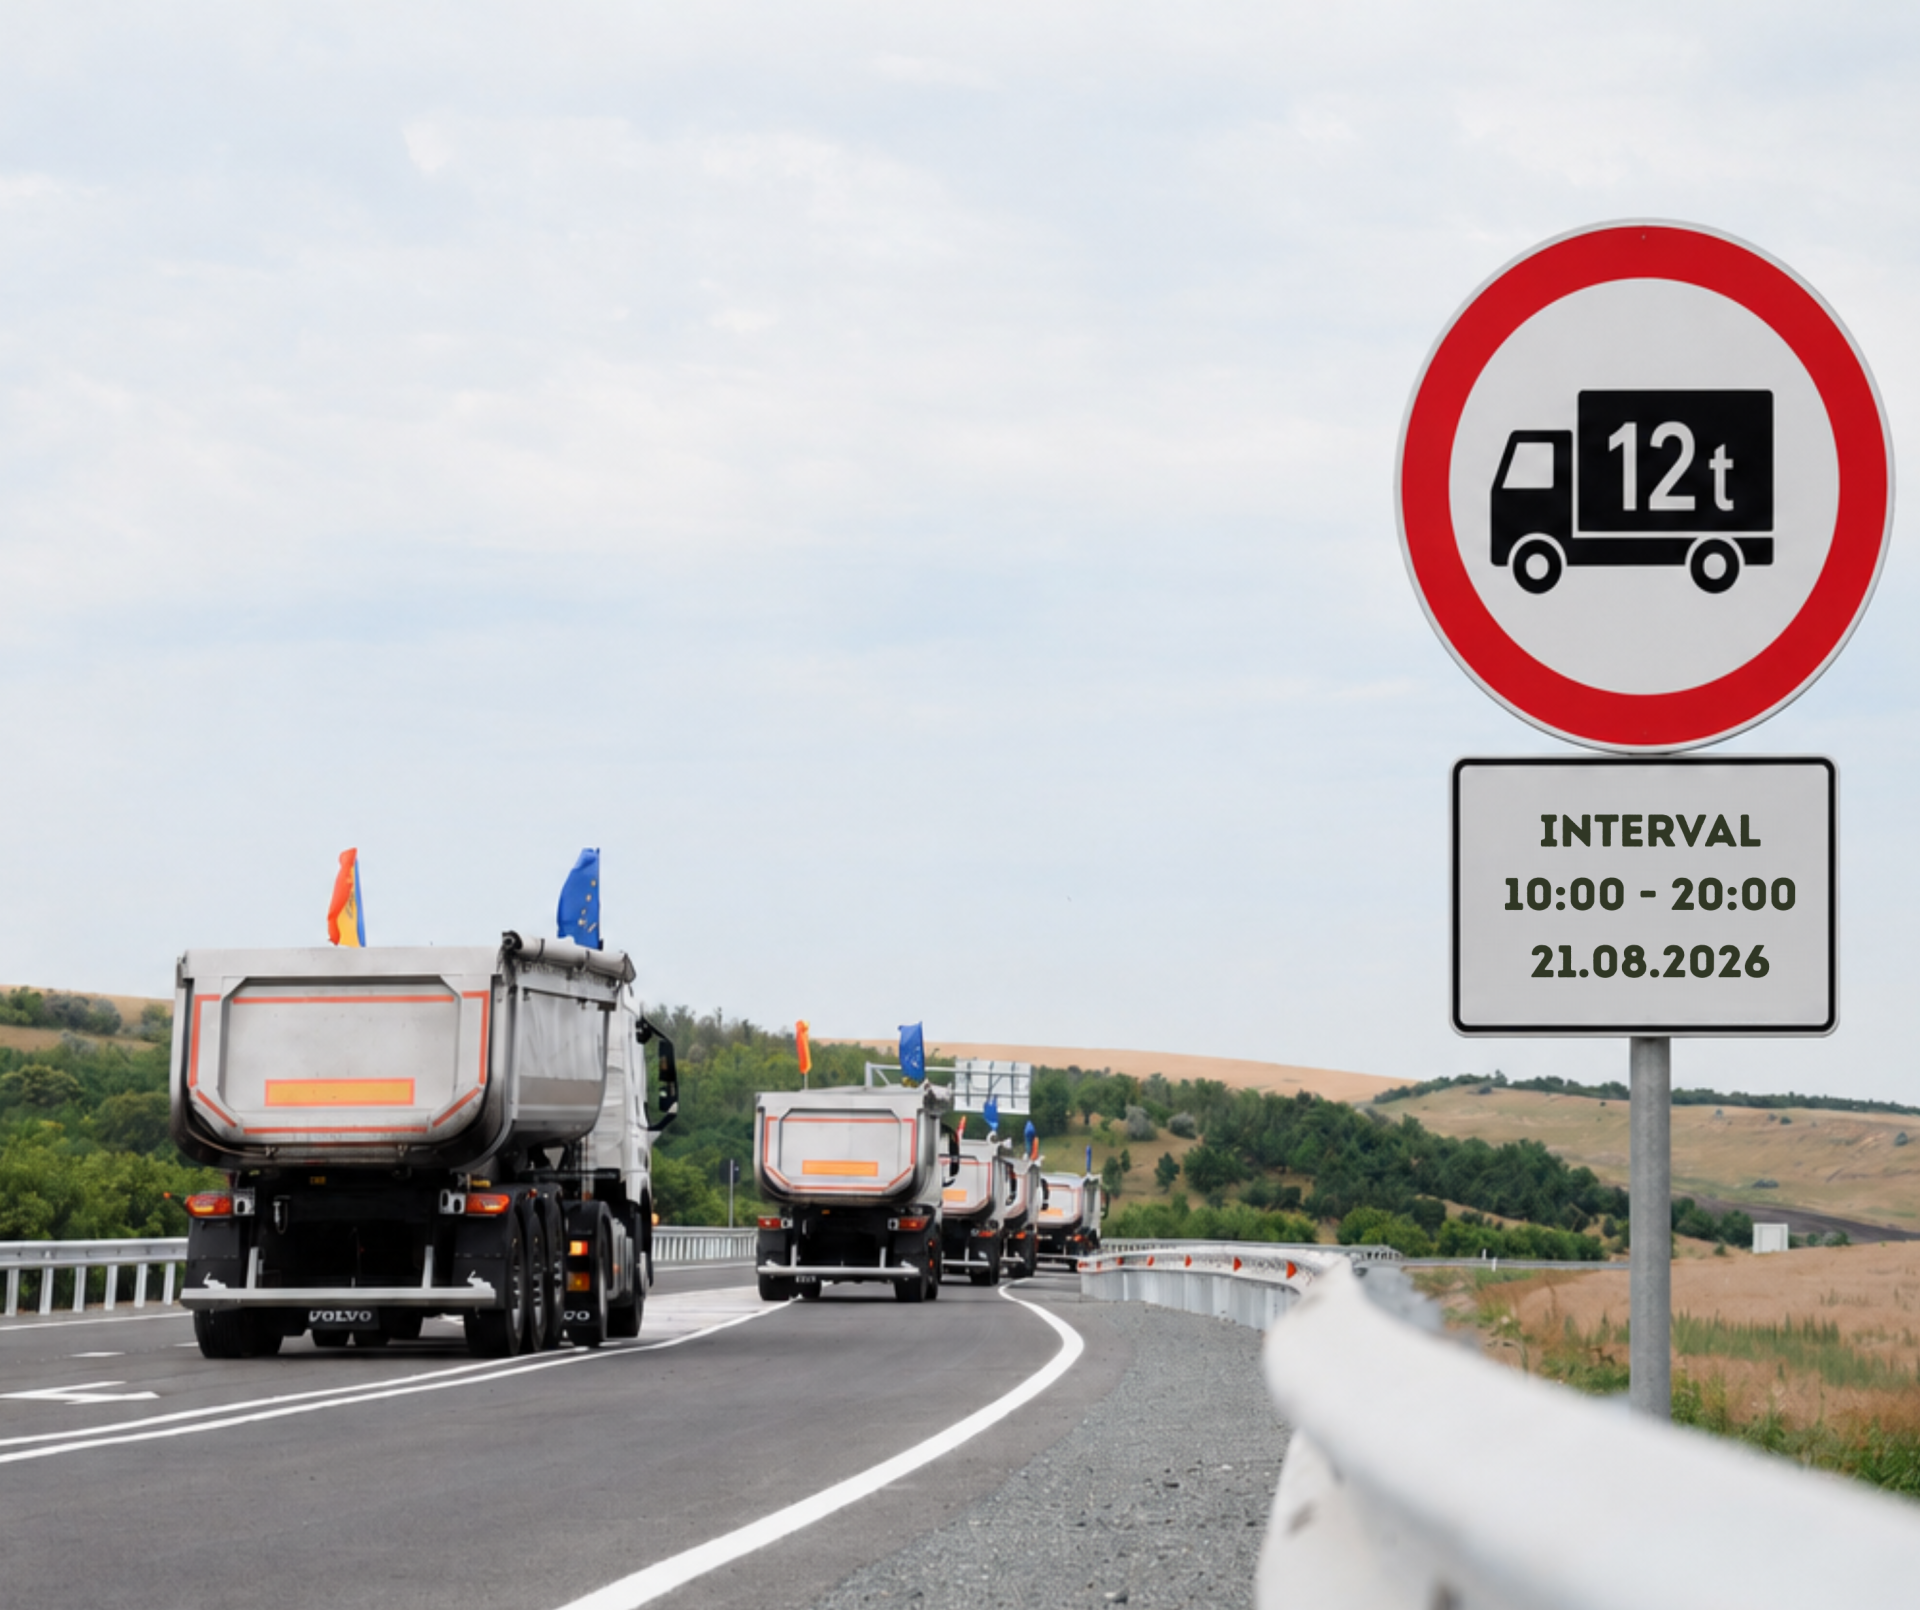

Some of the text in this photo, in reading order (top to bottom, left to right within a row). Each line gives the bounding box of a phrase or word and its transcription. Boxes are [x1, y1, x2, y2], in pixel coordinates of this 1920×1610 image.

[1540, 813, 1762, 848] INTERVAL
[1503, 877, 1797, 912] 10:00 - 20:00
[1530, 944, 1771, 979] 21.08.2026
[308, 1310, 372, 1323] VOLVO
